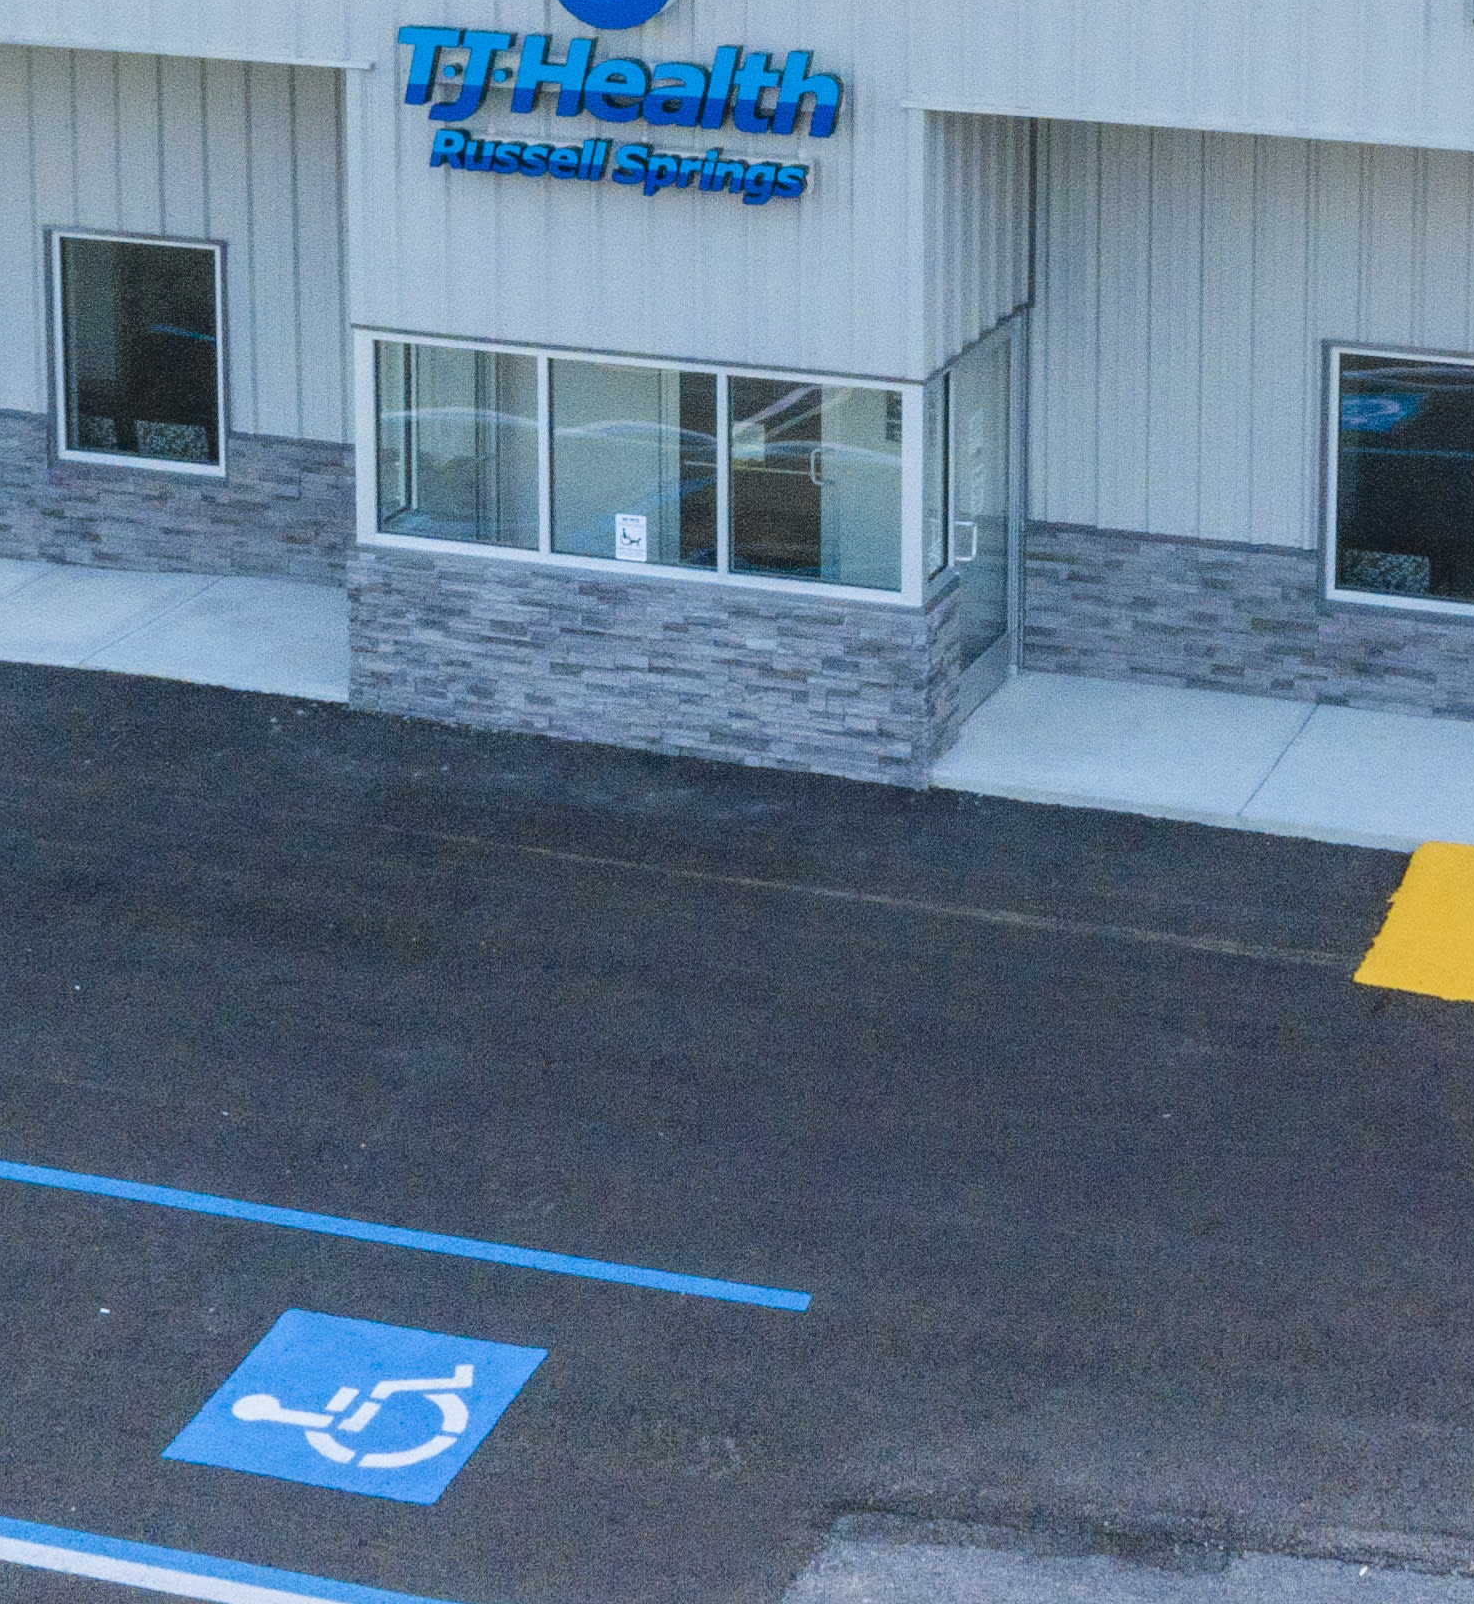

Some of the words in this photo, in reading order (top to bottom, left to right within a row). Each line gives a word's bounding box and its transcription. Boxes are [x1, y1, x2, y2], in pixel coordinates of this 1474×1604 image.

[510, 33, 842, 138] Health
[429, 128, 611, 182] Russell
[612, 147, 812, 205] Springs
